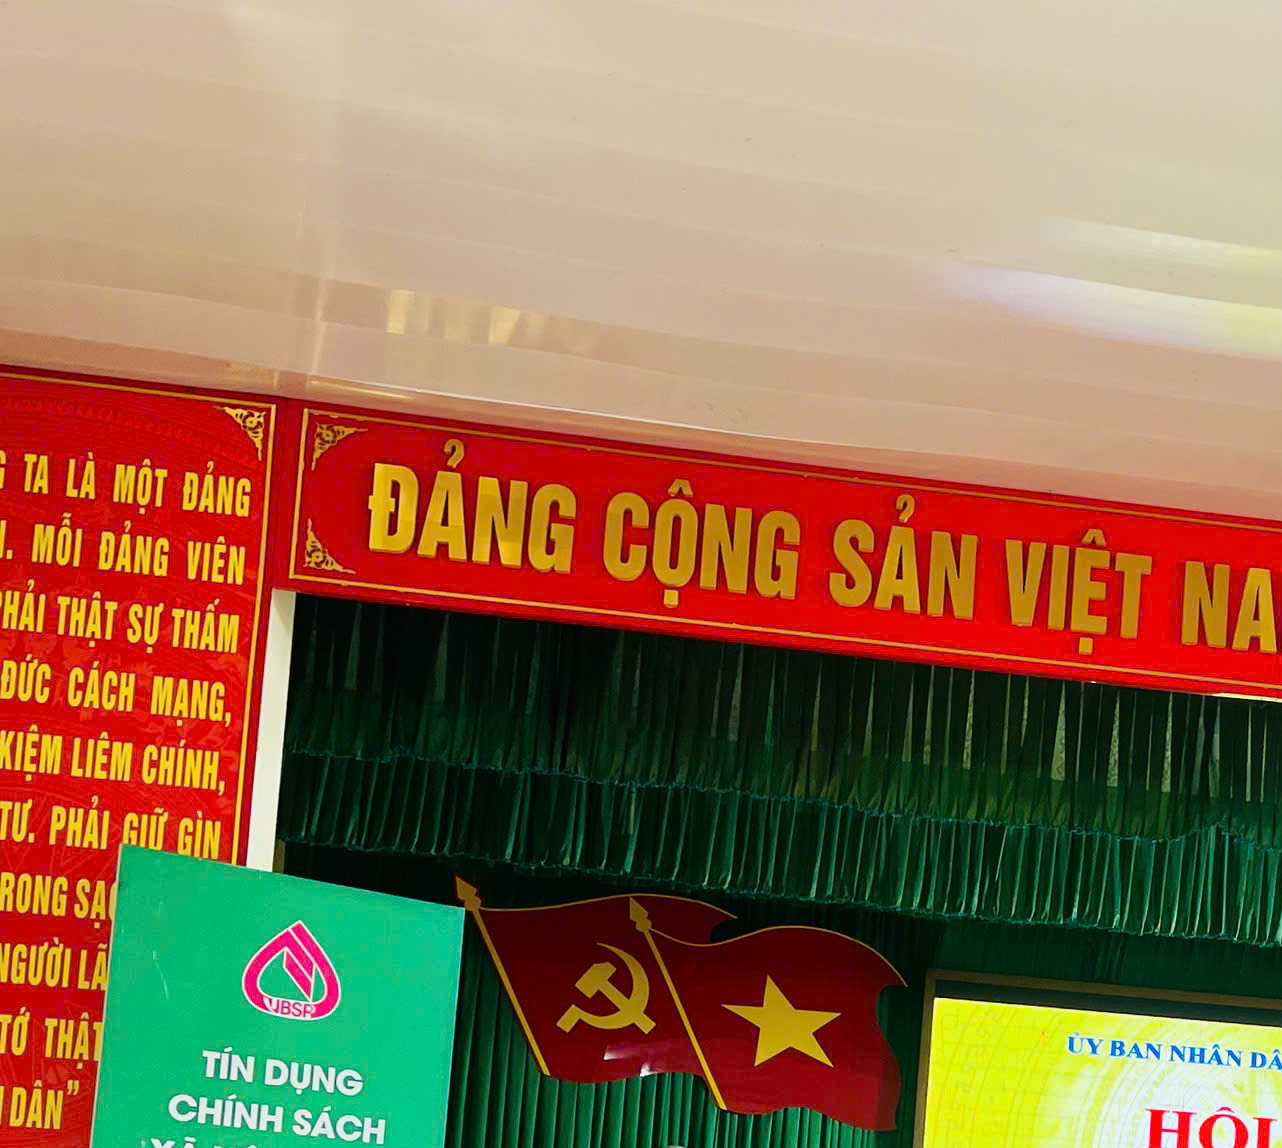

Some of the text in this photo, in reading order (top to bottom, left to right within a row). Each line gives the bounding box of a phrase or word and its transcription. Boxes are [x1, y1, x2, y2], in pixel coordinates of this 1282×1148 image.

[25, 454, 48, 494] TA
[67, 452, 95, 499] LÀ
[113, 459, 167, 514] MỘT
[183, 461, 251, 516] ĐẢNG
[32, 513, 82, 566] MỖI
[99, 520, 169, 576] ĐẢNG
[188, 536, 245, 584] VIÊN
[368, 439, 577, 575] ĐẢNG
[602, 479, 802, 608] CỘNG
[829, 494, 980, 620] SẢN
[1005, 530, 1152, 654] VIỆT
[58, 592, 239, 653] THẬT SỰ THẤM
[68, 661, 231, 727] CÁCH MẠNG,
[71, 732, 224, 796] LIÊM CHÍNH,
[49, 796, 109, 849] PHẢI
[203, 1048, 362, 1095] TÍN DỤNG
[1109, 1040, 1162, 1061] BAN
[1169, 1044, 1243, 1067] NHÂN
[169, 1095, 385, 1144] CHÍNH SÁCH
